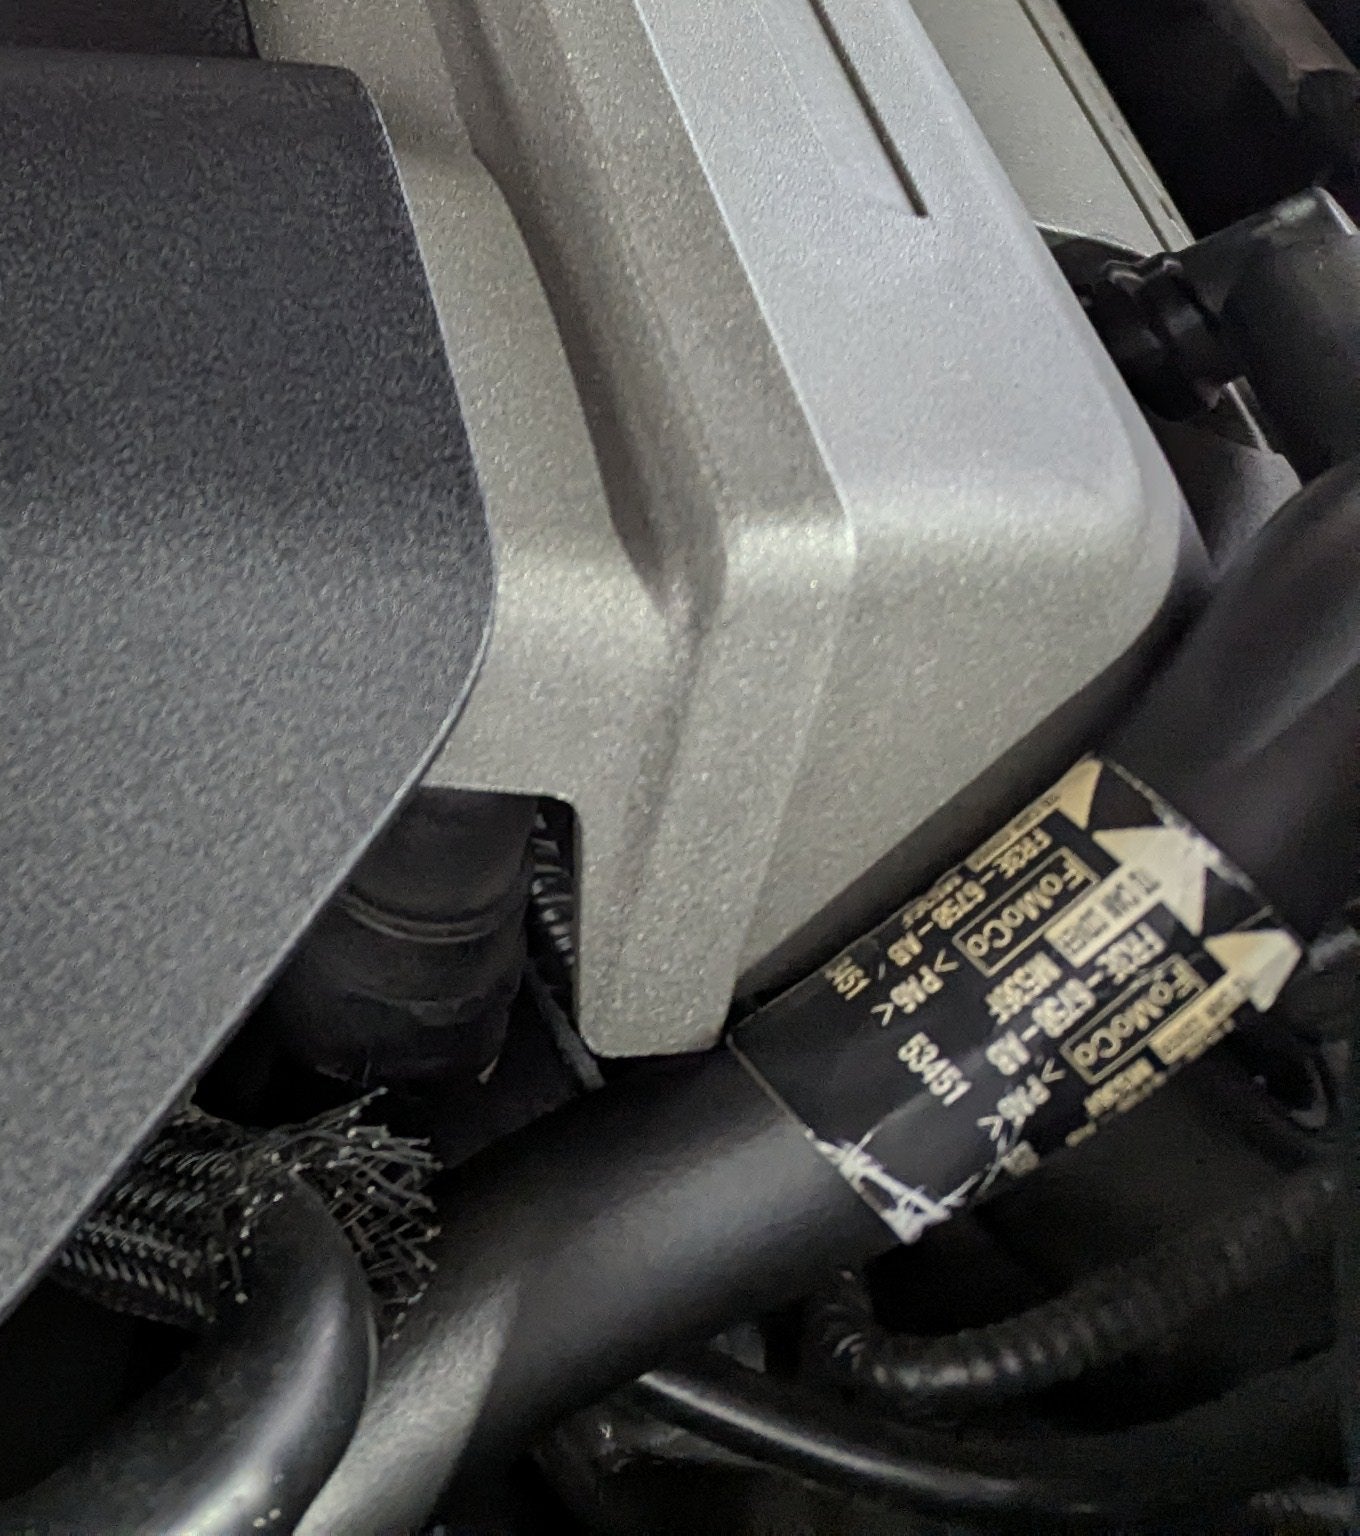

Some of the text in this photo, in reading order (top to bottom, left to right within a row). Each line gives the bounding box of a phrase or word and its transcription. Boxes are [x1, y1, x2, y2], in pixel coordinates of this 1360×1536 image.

[962, 853, 1084, 967] FoMoCo
[893, 1026, 972, 1111] 53451
[1069, 961, 1197, 1077] FoMoCo
